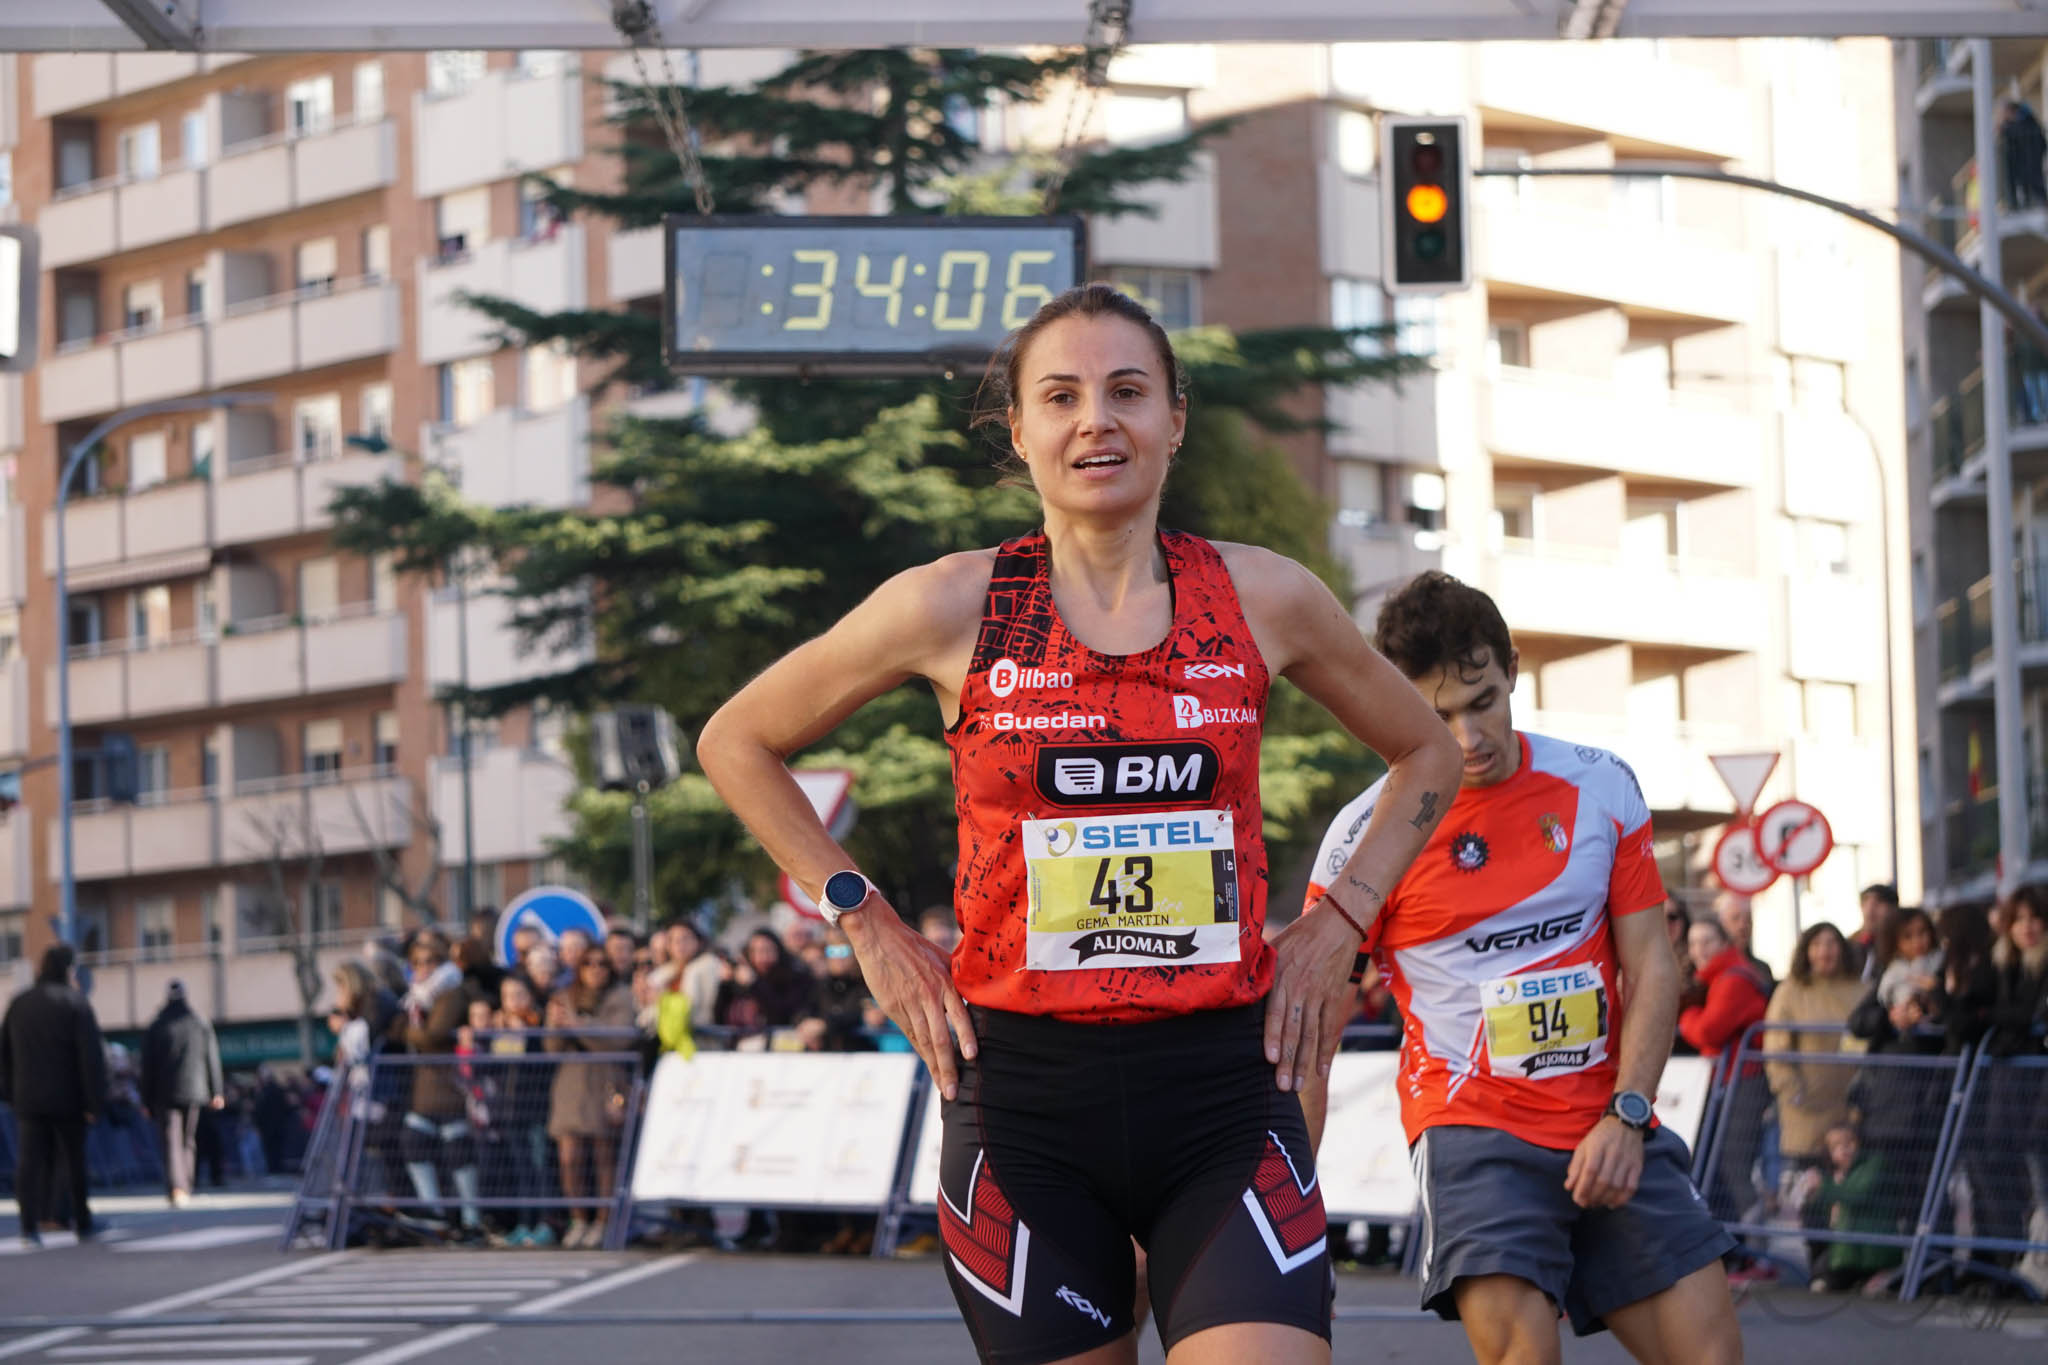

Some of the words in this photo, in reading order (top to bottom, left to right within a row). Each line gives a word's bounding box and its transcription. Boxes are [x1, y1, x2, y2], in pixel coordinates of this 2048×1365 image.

[992, 663, 1074, 692] Bilbao
[994, 712, 1106, 730] Guedan
[1203, 708, 1257, 724] BIZKAIA
[1115, 753, 1203, 794] BM
[1083, 821, 1214, 849] SETEL
[1090, 856, 1154, 914] 43
[1077, 917, 1110, 930] GEMA
[1118, 914, 1170, 926] MARTIN
[1465, 909, 1587, 953] VERGE
[1093, 935, 1178, 954] ALJOMAR
[1521, 970, 1595, 997] SETEL
[1528, 998, 1569, 1043] 94
[1534, 1052, 1583, 1069] ALJOMAR
